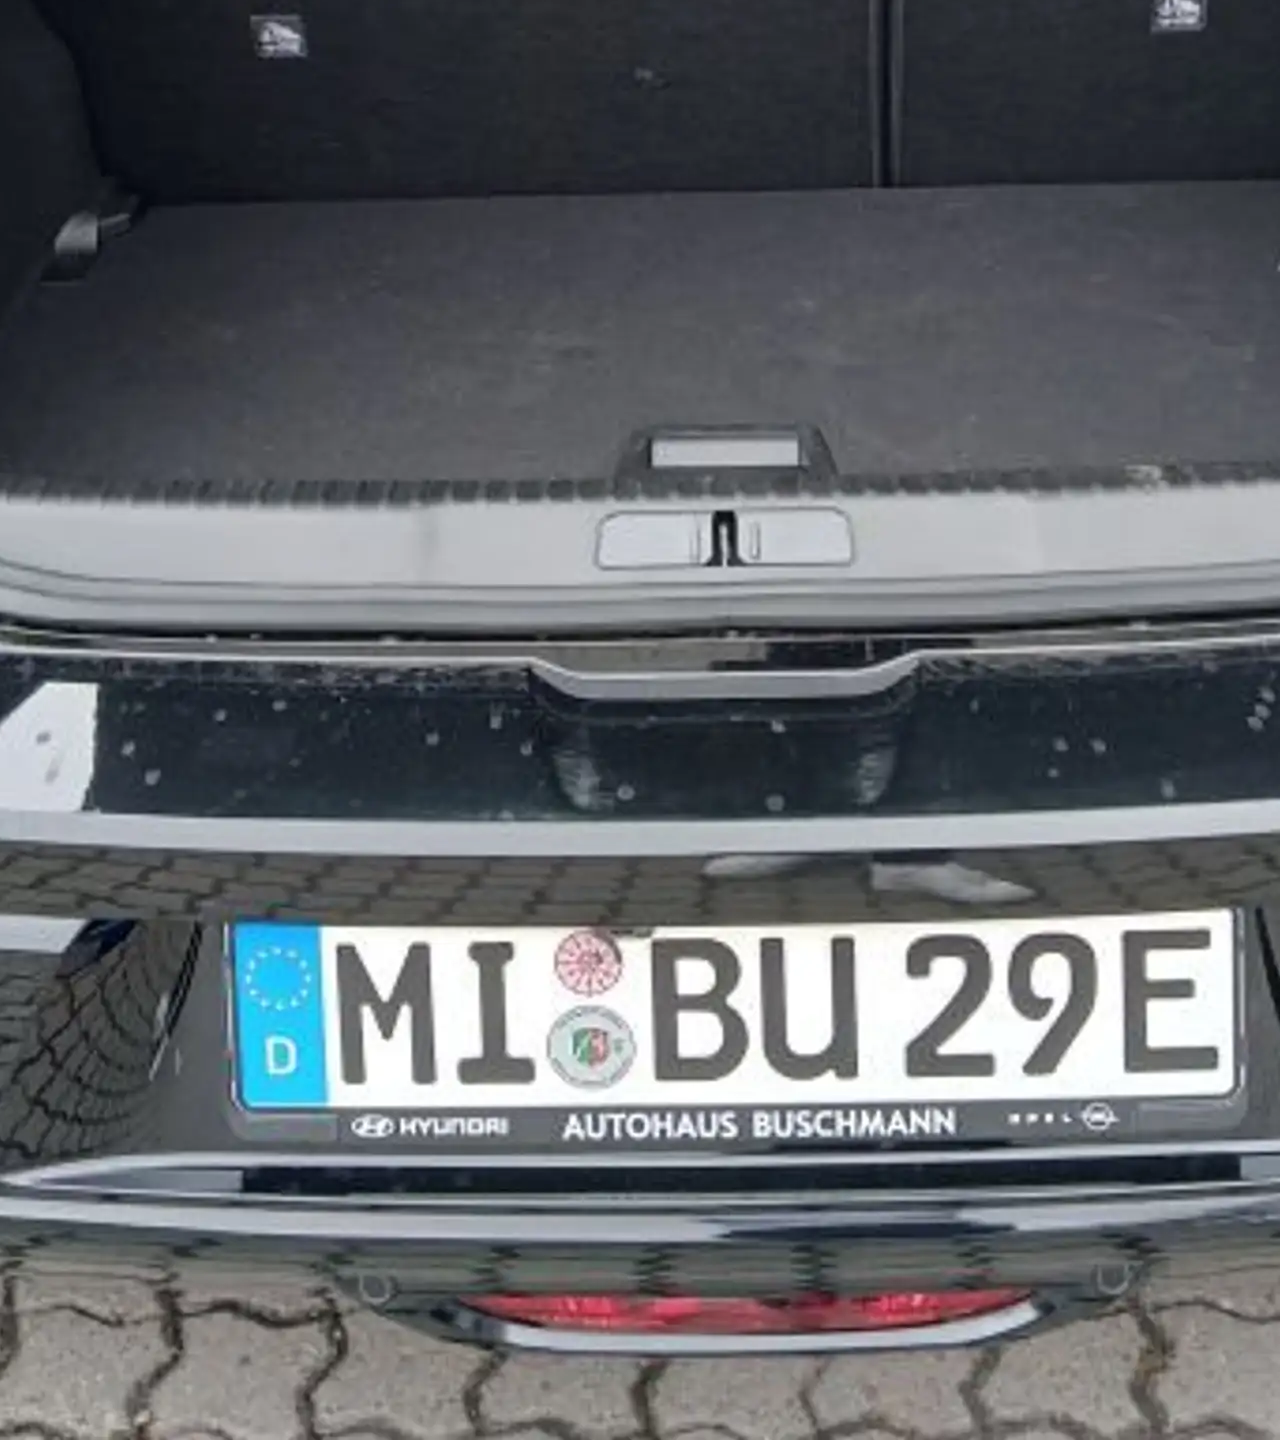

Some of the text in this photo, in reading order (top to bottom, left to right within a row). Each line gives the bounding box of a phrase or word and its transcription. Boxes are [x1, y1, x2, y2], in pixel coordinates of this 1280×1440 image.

[336, 941, 536, 1085] MI
[650, 936, 860, 1082] BU
[904, 928, 1220, 1078] 29E
[266, 1035, 297, 1075] D
[399, 1116, 510, 1137] HYUNDAI
[561, 1106, 958, 1142] AUTOHAUS BUSCHMANN
